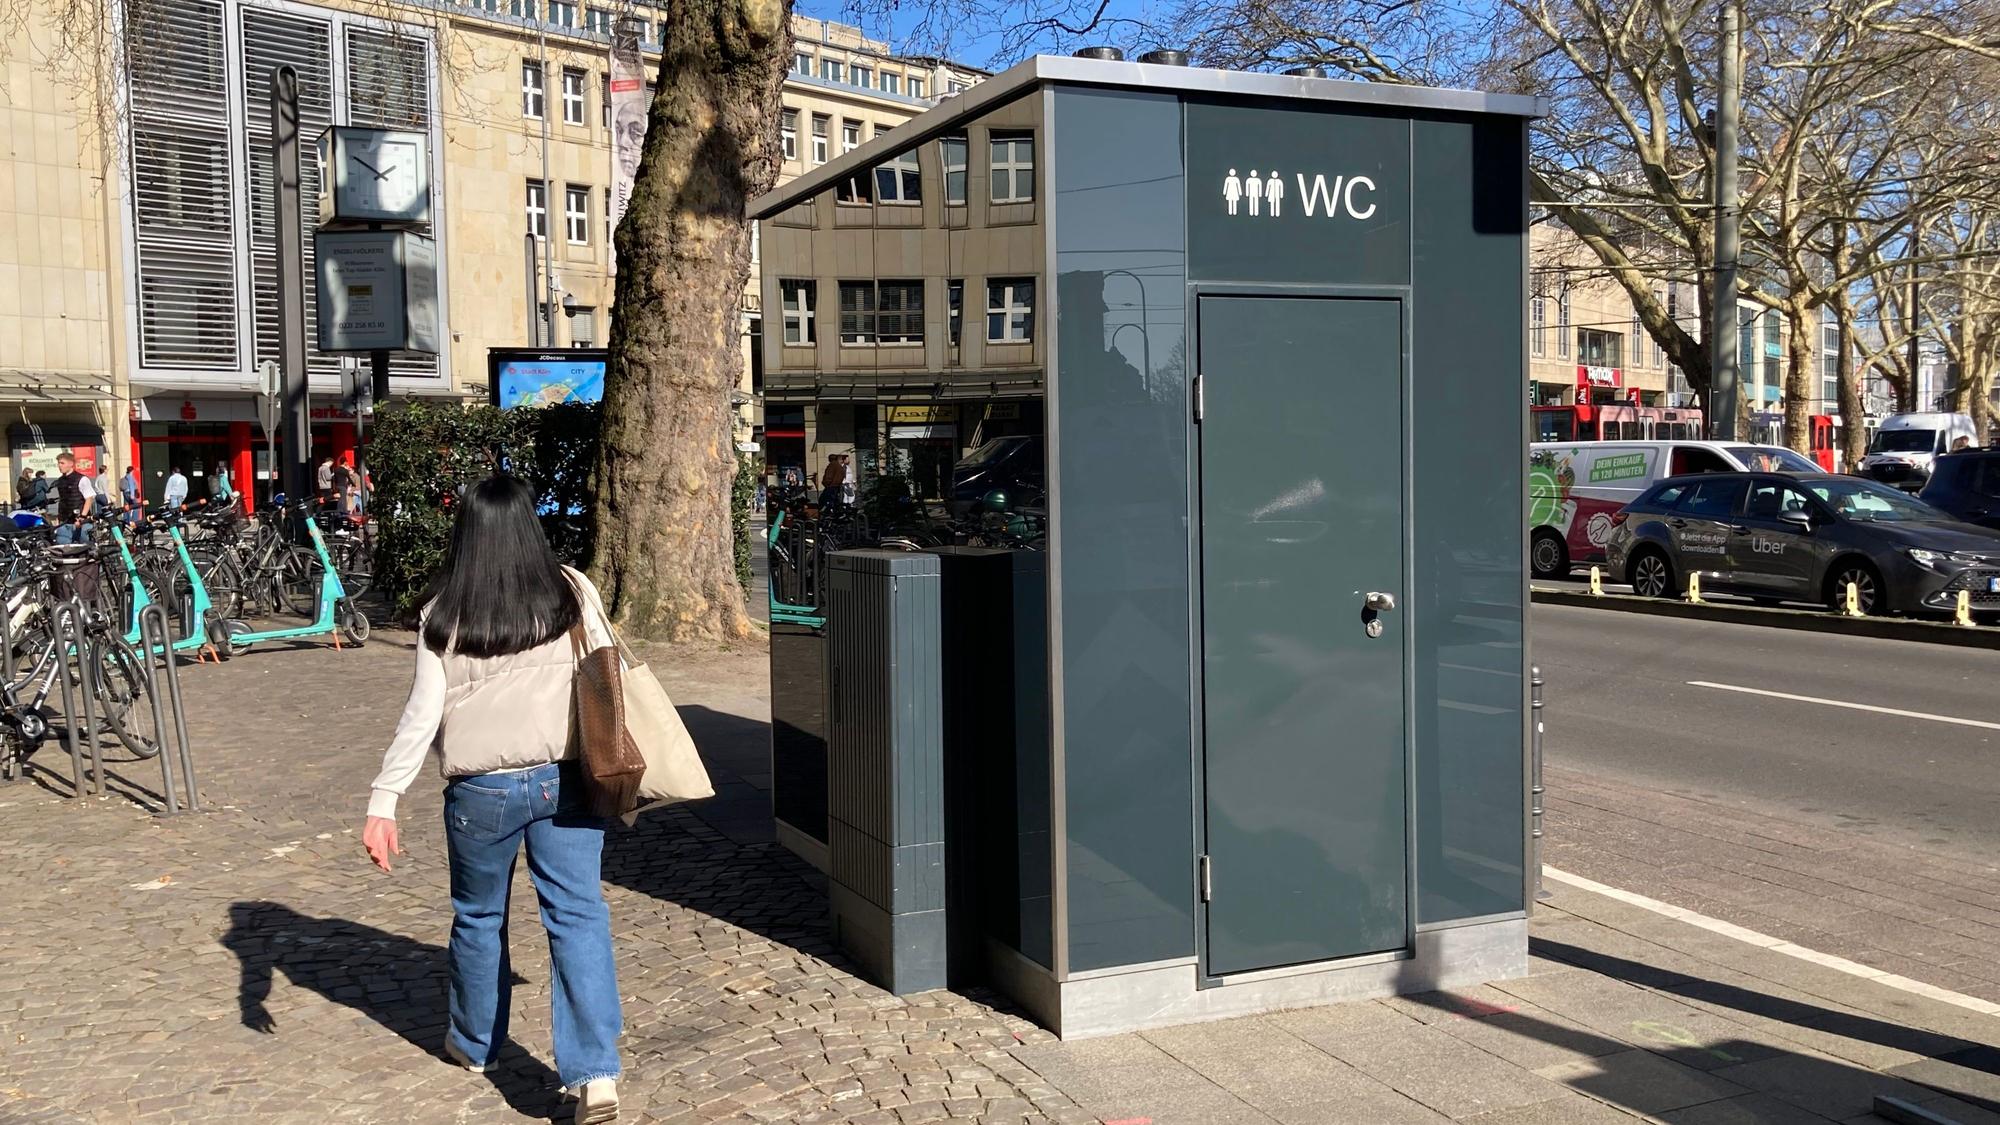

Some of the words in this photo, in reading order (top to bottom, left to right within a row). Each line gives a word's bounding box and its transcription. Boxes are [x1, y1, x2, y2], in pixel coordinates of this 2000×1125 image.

[617, 181, 627, 222] OLLWITZ
[1296, 173, 1377, 220] WC
[1596, 458, 1613, 469] DEIN
[1613, 455, 1642, 467] EINKAUF
[1591, 471, 1600, 480] IN
[1613, 465, 1644, 478] MINUTEN
[1686, 533, 1701, 542] Jetzt
[1701, 534, 1711, 542] die
[1711, 534, 1726, 545] App
[1752, 537, 1786, 555] Uber
[1681, 544, 1720, 554] downloaden
